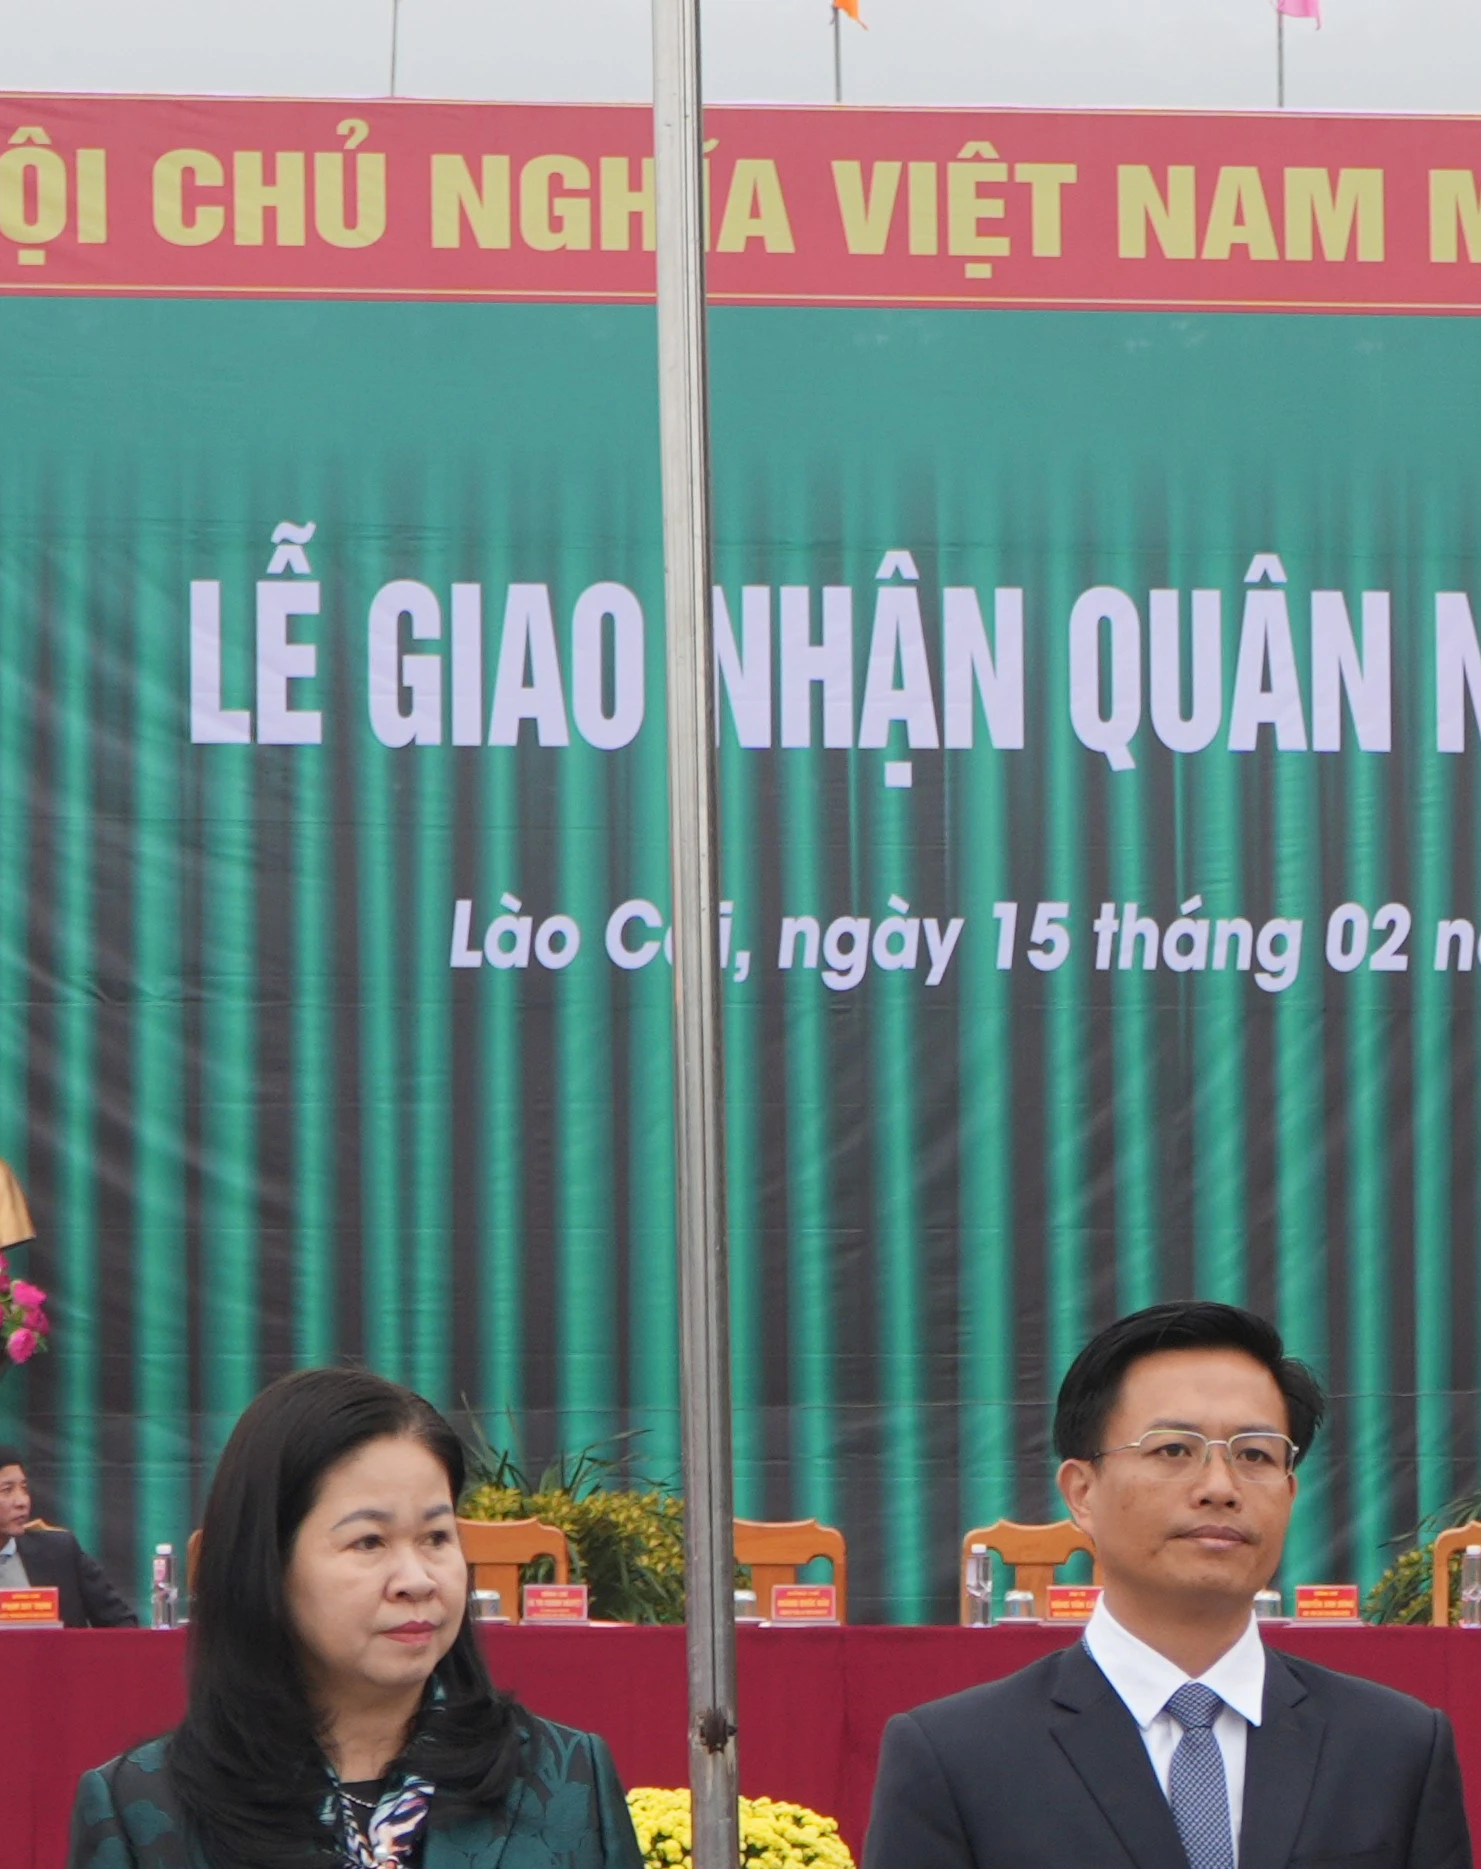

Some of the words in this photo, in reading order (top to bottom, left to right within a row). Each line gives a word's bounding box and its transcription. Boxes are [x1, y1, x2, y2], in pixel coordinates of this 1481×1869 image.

[152, 118, 387, 247] CHỦ
[431, 139, 795, 253] NGHA
[833, 141, 1078, 280] VIỆT
[1117, 163, 1386, 262] NAM
[188, 520, 322, 745] LỄ
[368, 580, 645, 752] GIAO
[710, 549, 1026, 789] NHẬN
[1069, 552, 1393, 771] QUÂN
[449, 891, 581, 970] Lào
[604, 898, 751, 984] Ci,
[777, 893, 964, 992] ngày
[994, 899, 1070, 970] 15
[1093, 895, 1304, 993] tháng
[1324, 900, 1412, 973] 02
